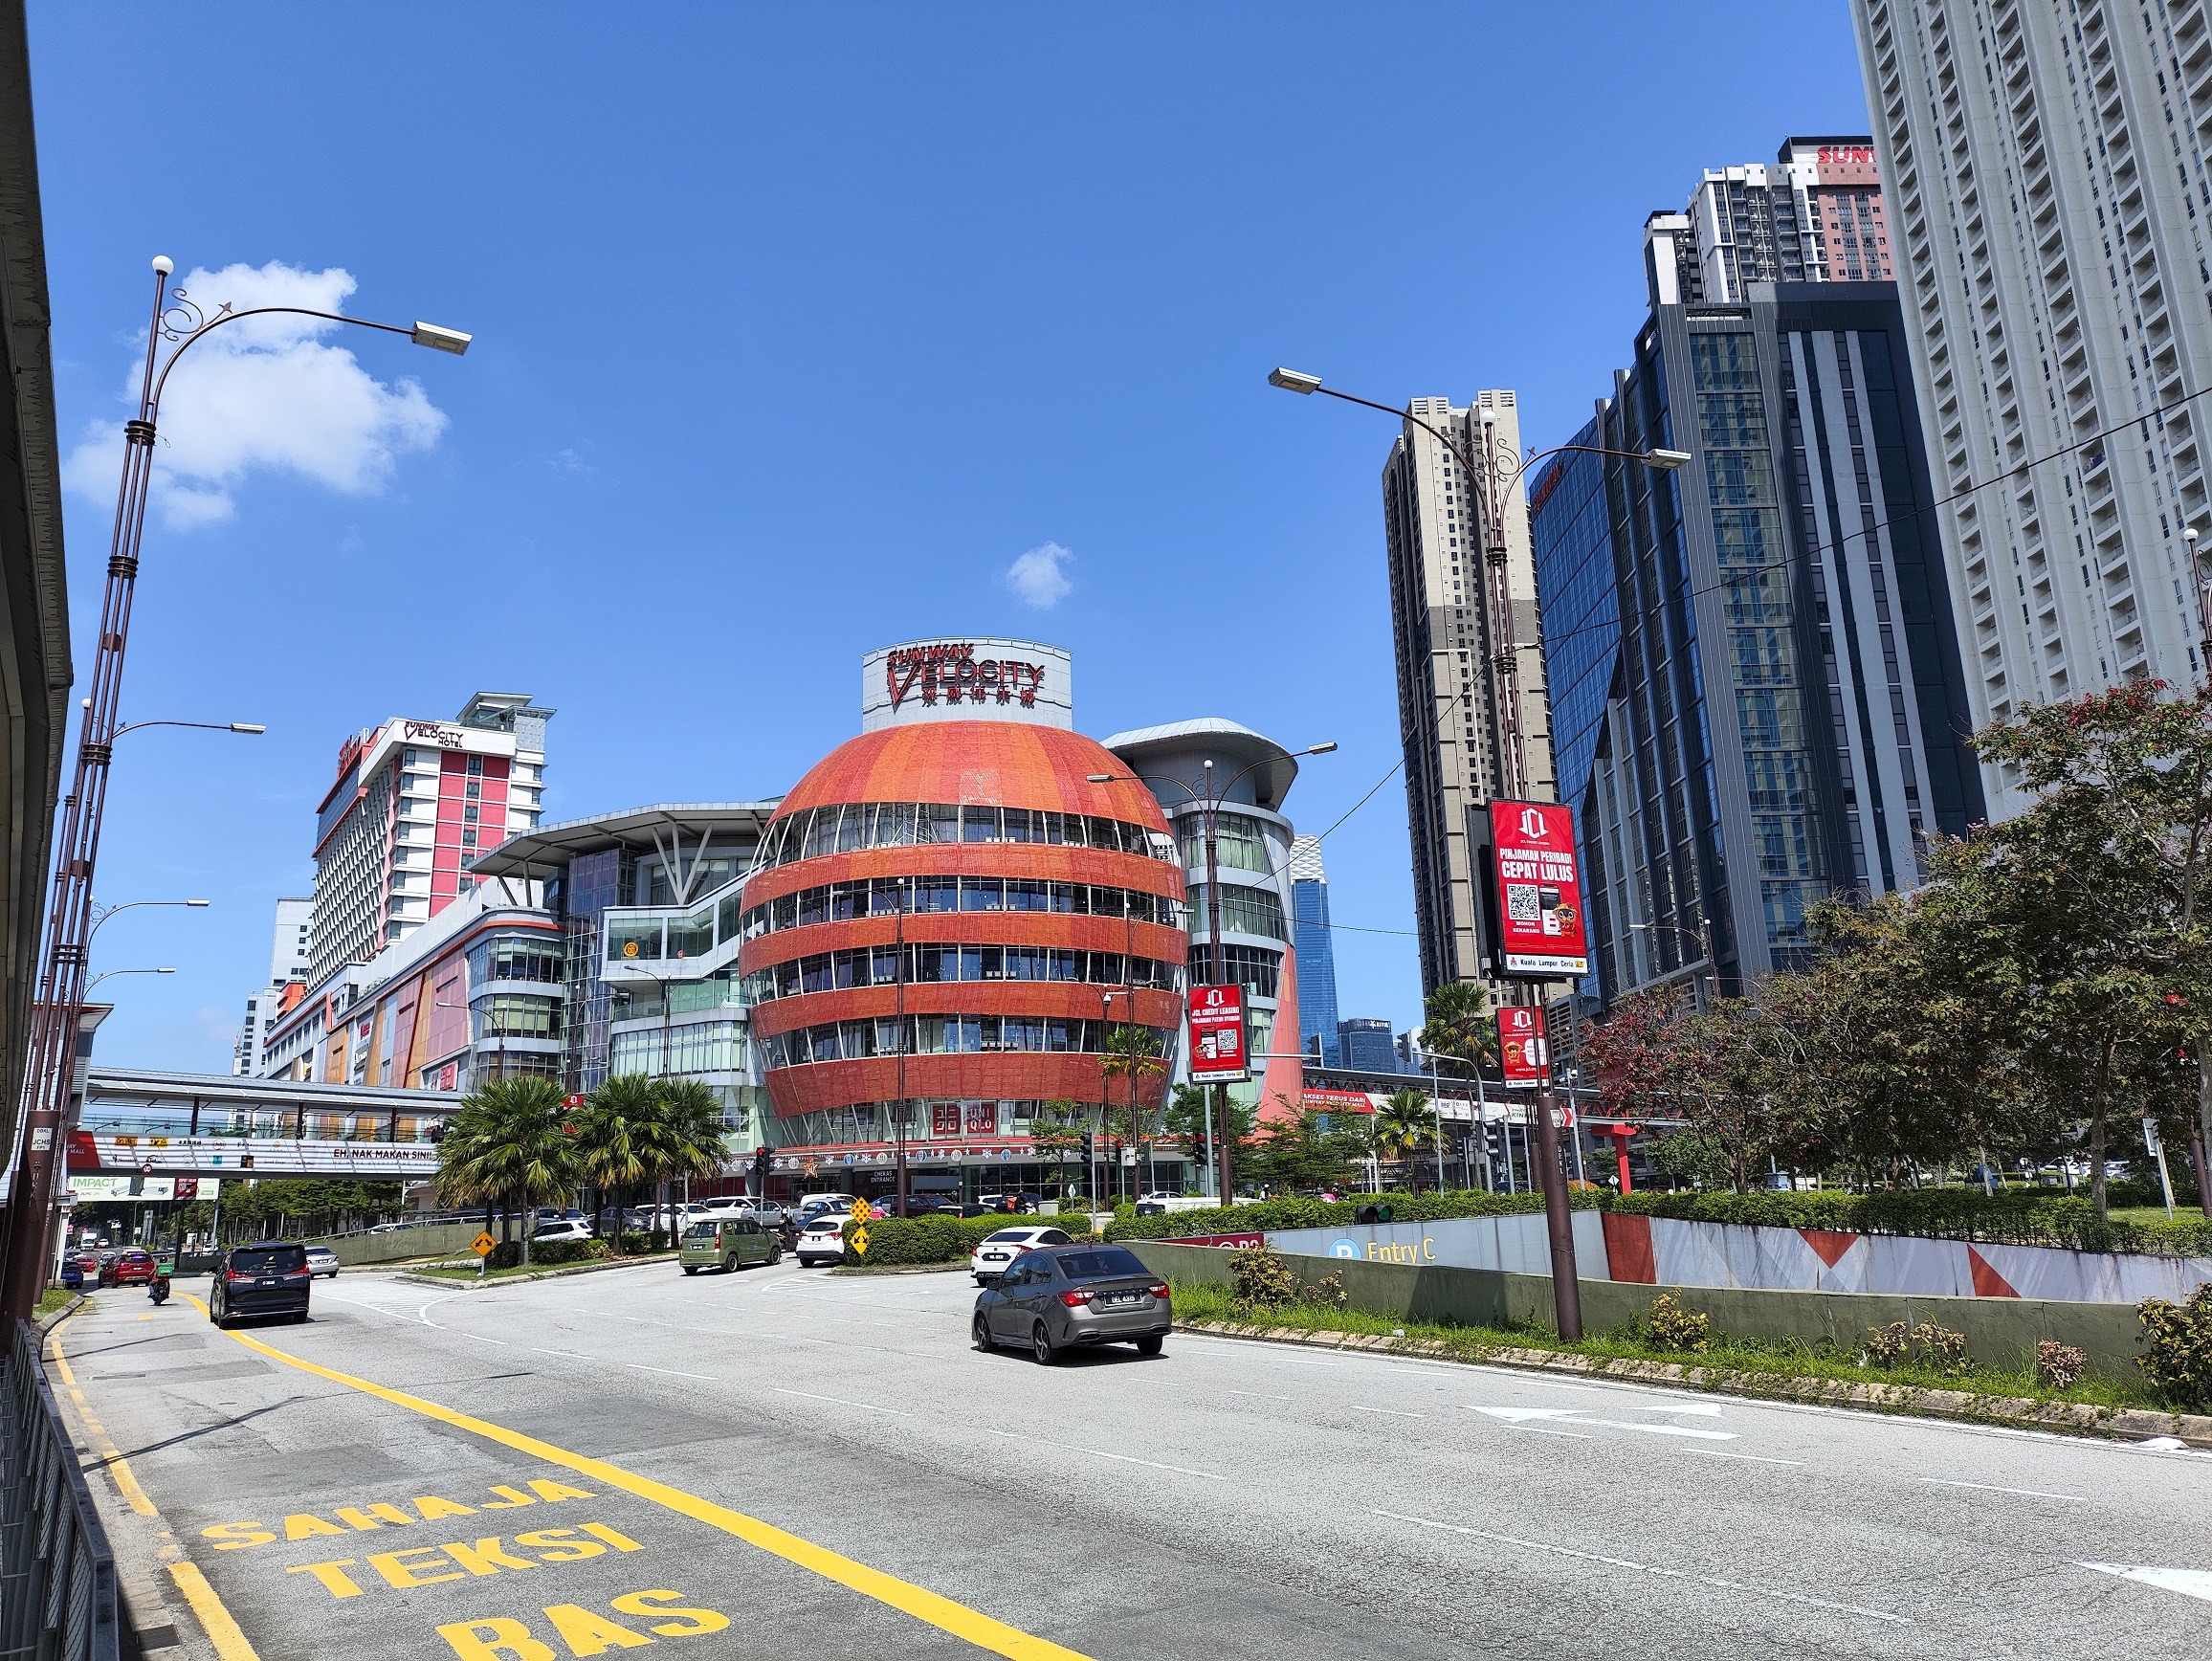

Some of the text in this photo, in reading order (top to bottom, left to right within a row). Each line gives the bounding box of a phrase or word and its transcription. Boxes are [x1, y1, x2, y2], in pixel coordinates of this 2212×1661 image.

[1818, 145, 1876, 164] SUN
[887, 643, 974, 666] SUNWAY
[887, 659, 1045, 704] VELOCITY
[404, 724, 464, 742] VELOCITY
[438, 739, 463, 748] HOTEL
[1499, 848, 1573, 865] PINJAMAN PERIBADI
[1501, 861, 1574, 882] CEPAT LULUS
[1520, 958, 1537, 966] Kuala
[1538, 960, 1558, 968] Lumpur
[969, 1118, 992, 1132] QLO
[333, 1148, 349, 1159] EH,
[352, 1149, 372, 1159] NAK
[375, 1150, 409, 1160] MAKAN
[73, 1178, 118, 1187] IMPACT
[1367, 1237, 1437, 1263] Entry C
[200, 1479, 598, 1552] SAHAJA
[285, 1522, 646, 1599] TEKSI
[436, 1589, 731, 1661] BAS
